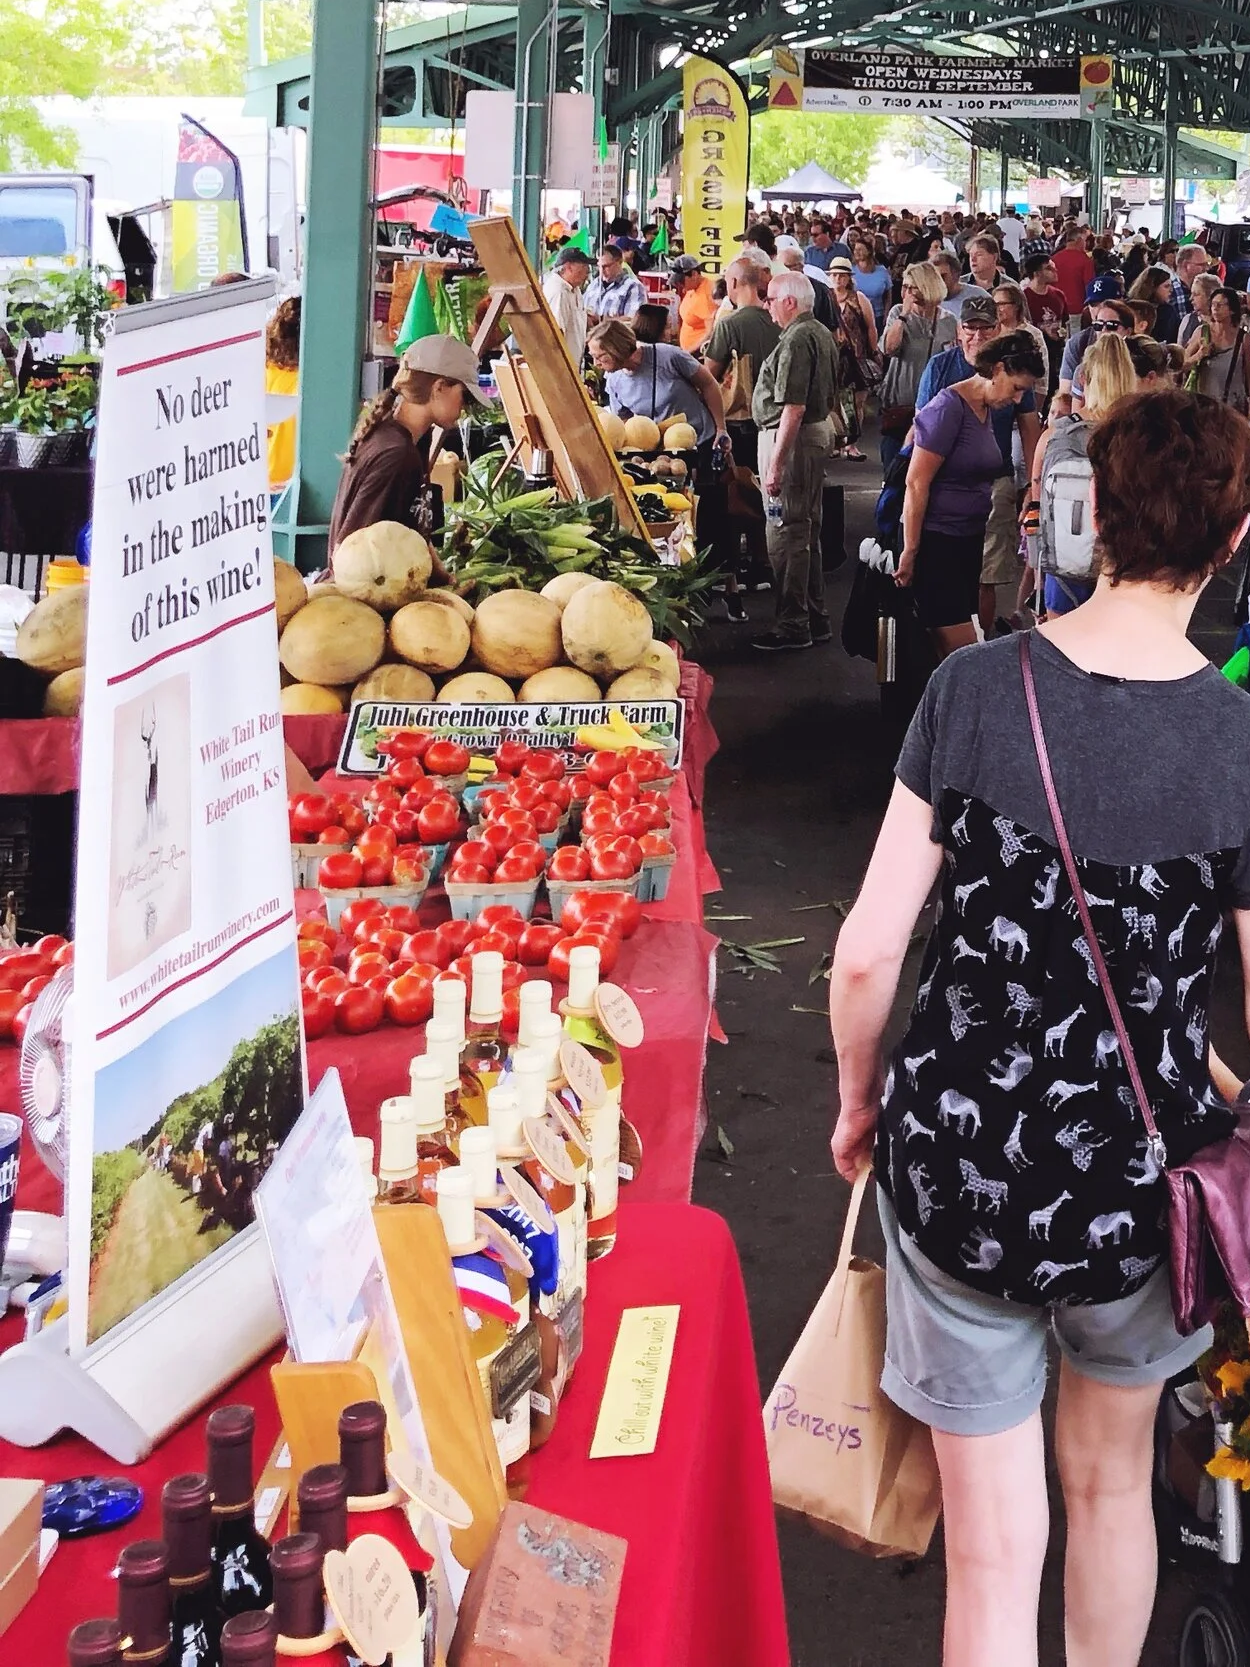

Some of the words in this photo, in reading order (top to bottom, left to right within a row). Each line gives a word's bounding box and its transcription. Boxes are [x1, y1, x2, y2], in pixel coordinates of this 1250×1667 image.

[811, 50, 891, 64] OVERLAND
[895, 55, 934, 66] PARK
[1013, 58, 1076, 68] MARKET
[852, 77, 930, 91] THROUGH
[936, 81, 1034, 92] SEPTEMBER
[865, 65, 908, 78] OPEN
[914, 67, 1022, 81] WEDNESDAYS
[882, 97, 912, 107] 7:30
[916, 99, 942, 109] AM
[958, 100, 985, 110] 1:00
[989, 100, 1012, 110] PM
[1012, 99, 1058, 107] OVERLAND
[1058, 99, 1079, 107] PARK
[156, 385, 185, 430] No
[191, 376, 232, 418] deer
[127, 461, 177, 506] were
[184, 422, 261, 486] harmed
[122, 534, 144, 578] in
[150, 519, 184, 565] the
[191, 490, 267, 548] making
[131, 592, 153, 643] of
[157, 577, 200, 629] this
[206, 547, 261, 607] wine!
[200, 736, 231, 766] White
[232, 718, 255, 747] Tail
[259, 711, 280, 735] Run
[368, 705, 410, 728] Juhl
[415, 706, 530, 727] Greenhouse
[535, 706, 551, 727] &
[559, 705, 611, 726] Truck
[220, 750, 262, 783] Winery
[205, 782, 259, 827] Edgerton,
[263, 765, 280, 792] KS
[119, 897, 280, 1009] www.whitetailrunwinery.com
[770, 1383, 863, 1455] Penzeys
